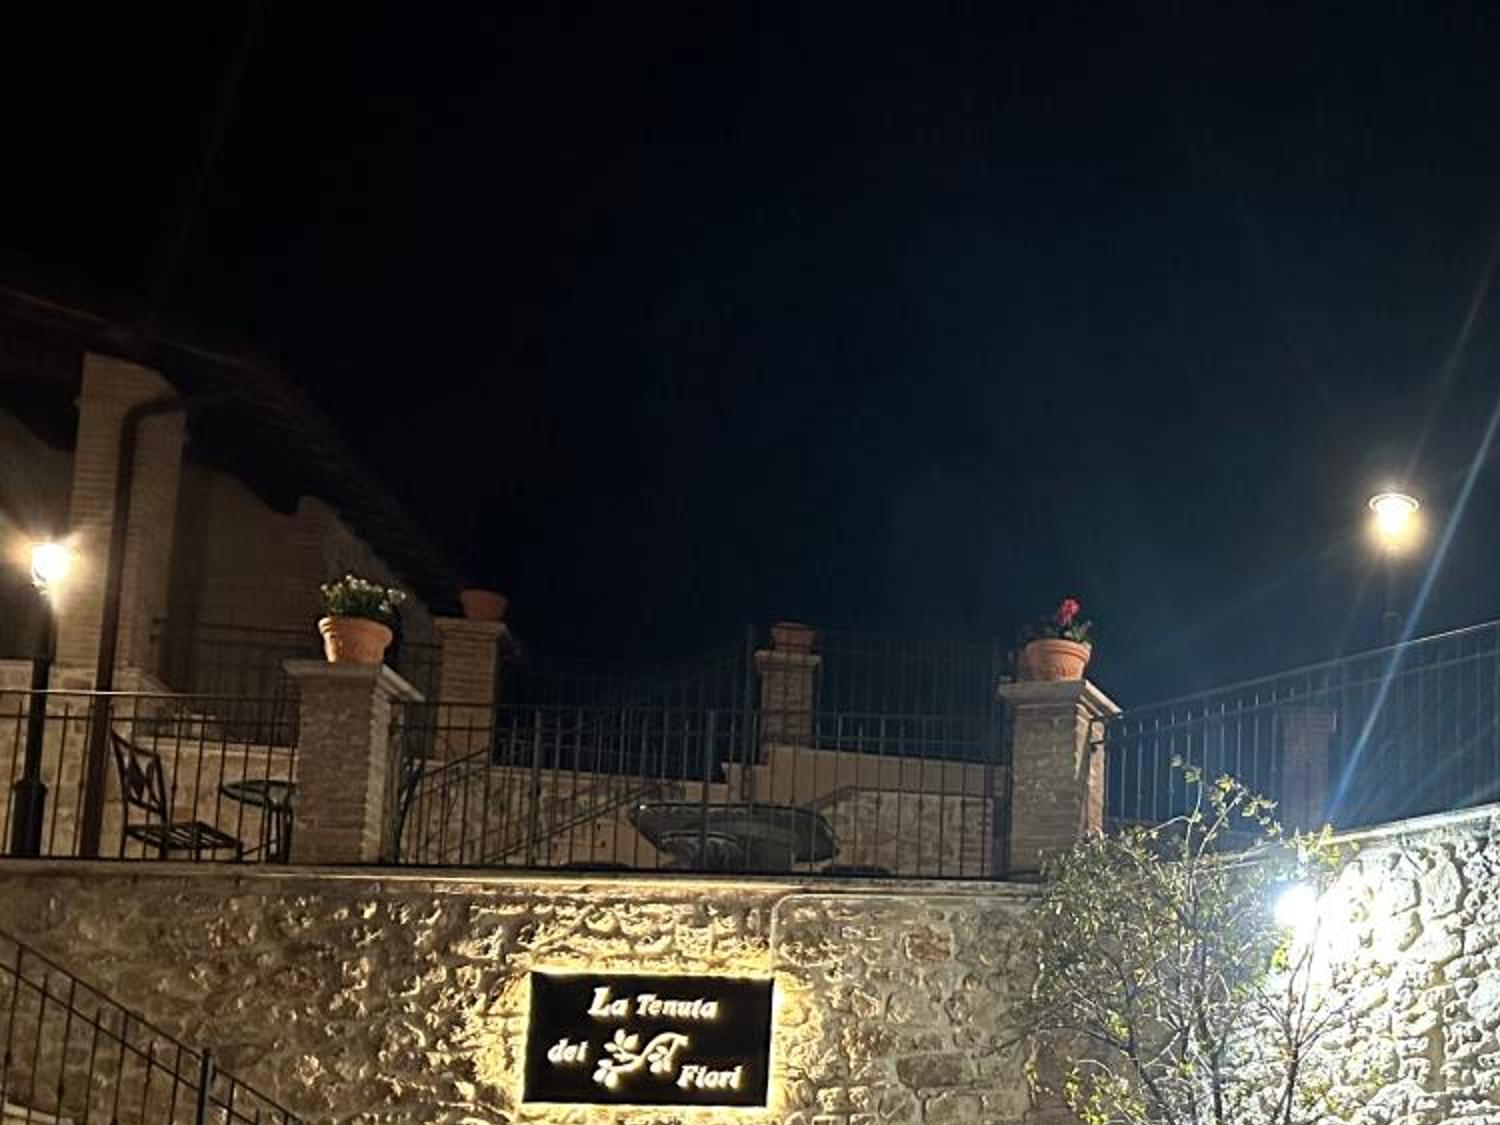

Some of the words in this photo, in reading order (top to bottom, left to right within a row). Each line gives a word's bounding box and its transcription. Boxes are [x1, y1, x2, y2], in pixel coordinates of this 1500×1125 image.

[588, 987, 629, 1017] La
[636, 994, 718, 1019] Tenuta
[547, 1038, 588, 1062] dei
[676, 1065, 742, 1089] Fiori
